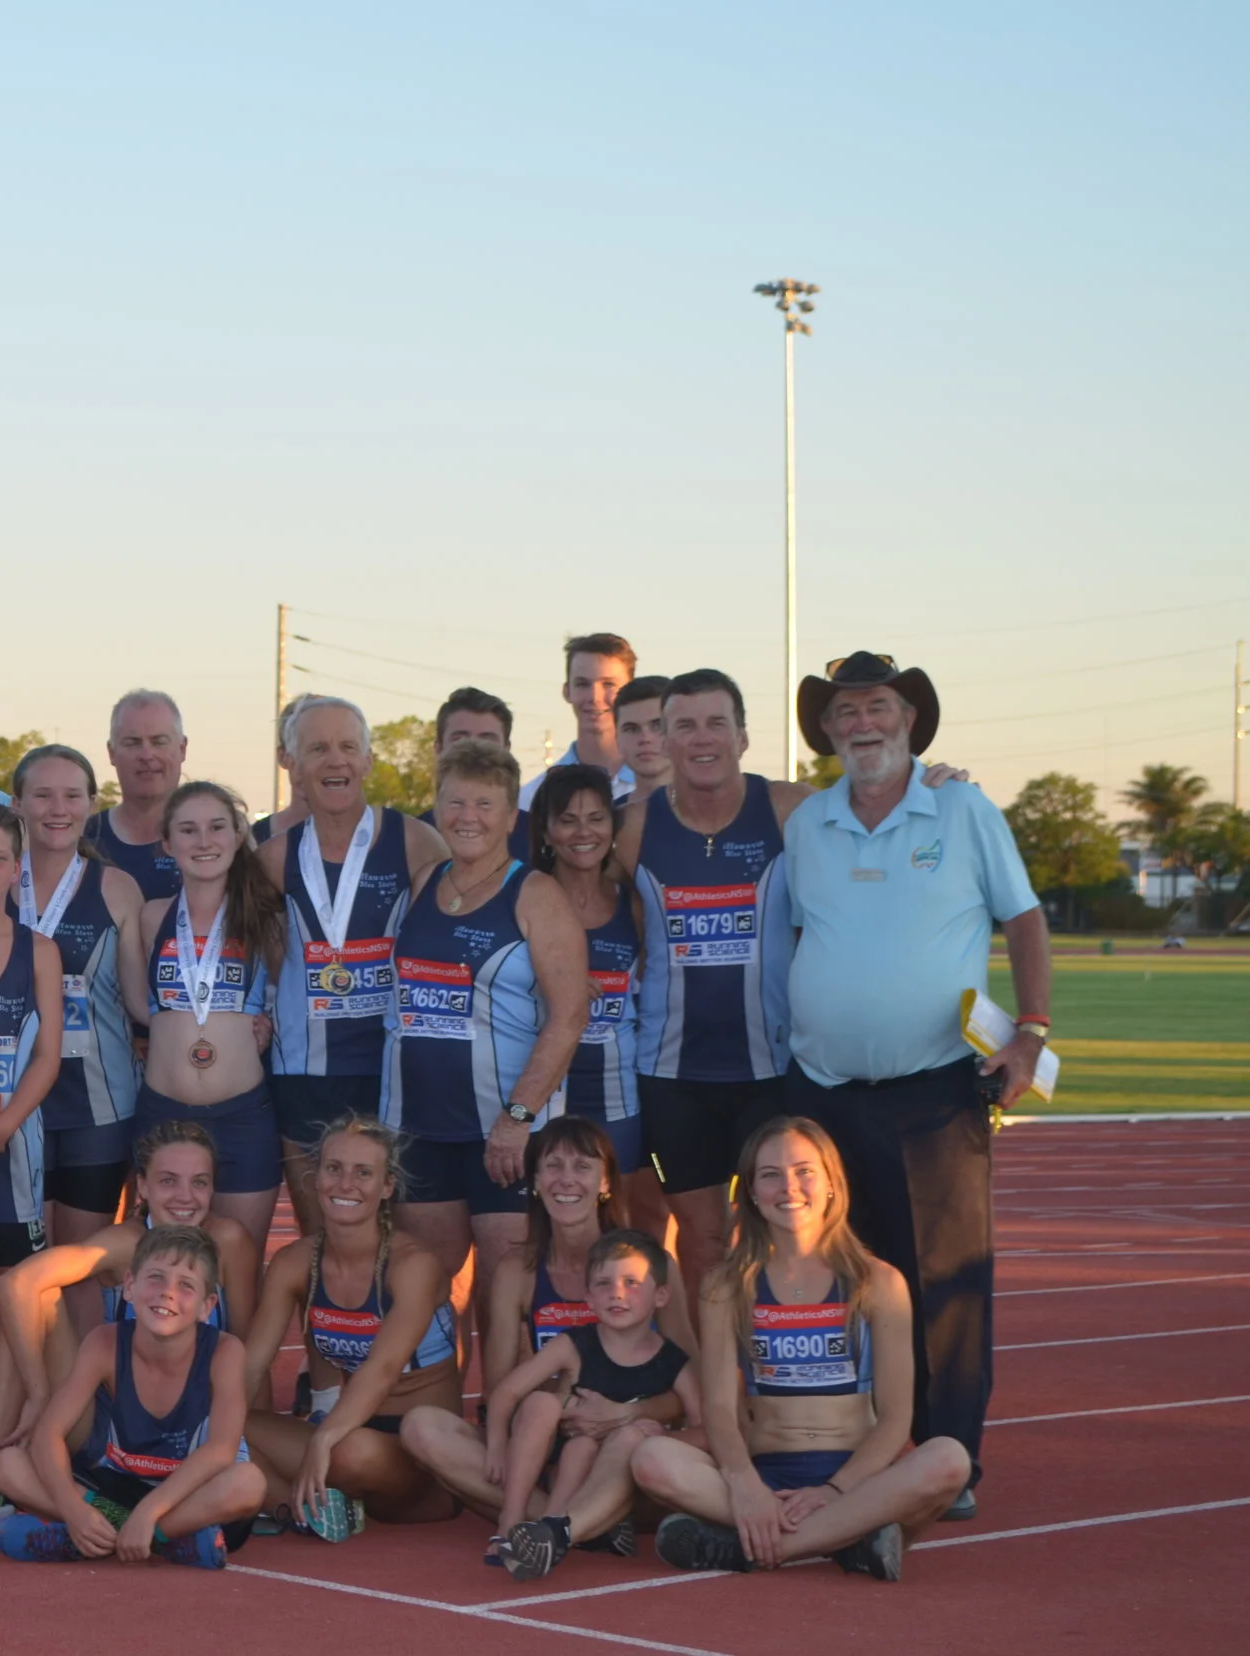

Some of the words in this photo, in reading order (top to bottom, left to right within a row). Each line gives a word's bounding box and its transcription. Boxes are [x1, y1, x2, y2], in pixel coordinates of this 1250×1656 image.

[687, 913, 733, 936] 1679
[410, 987, 450, 1009] 1662
[772, 1335, 824, 1359] 1690
